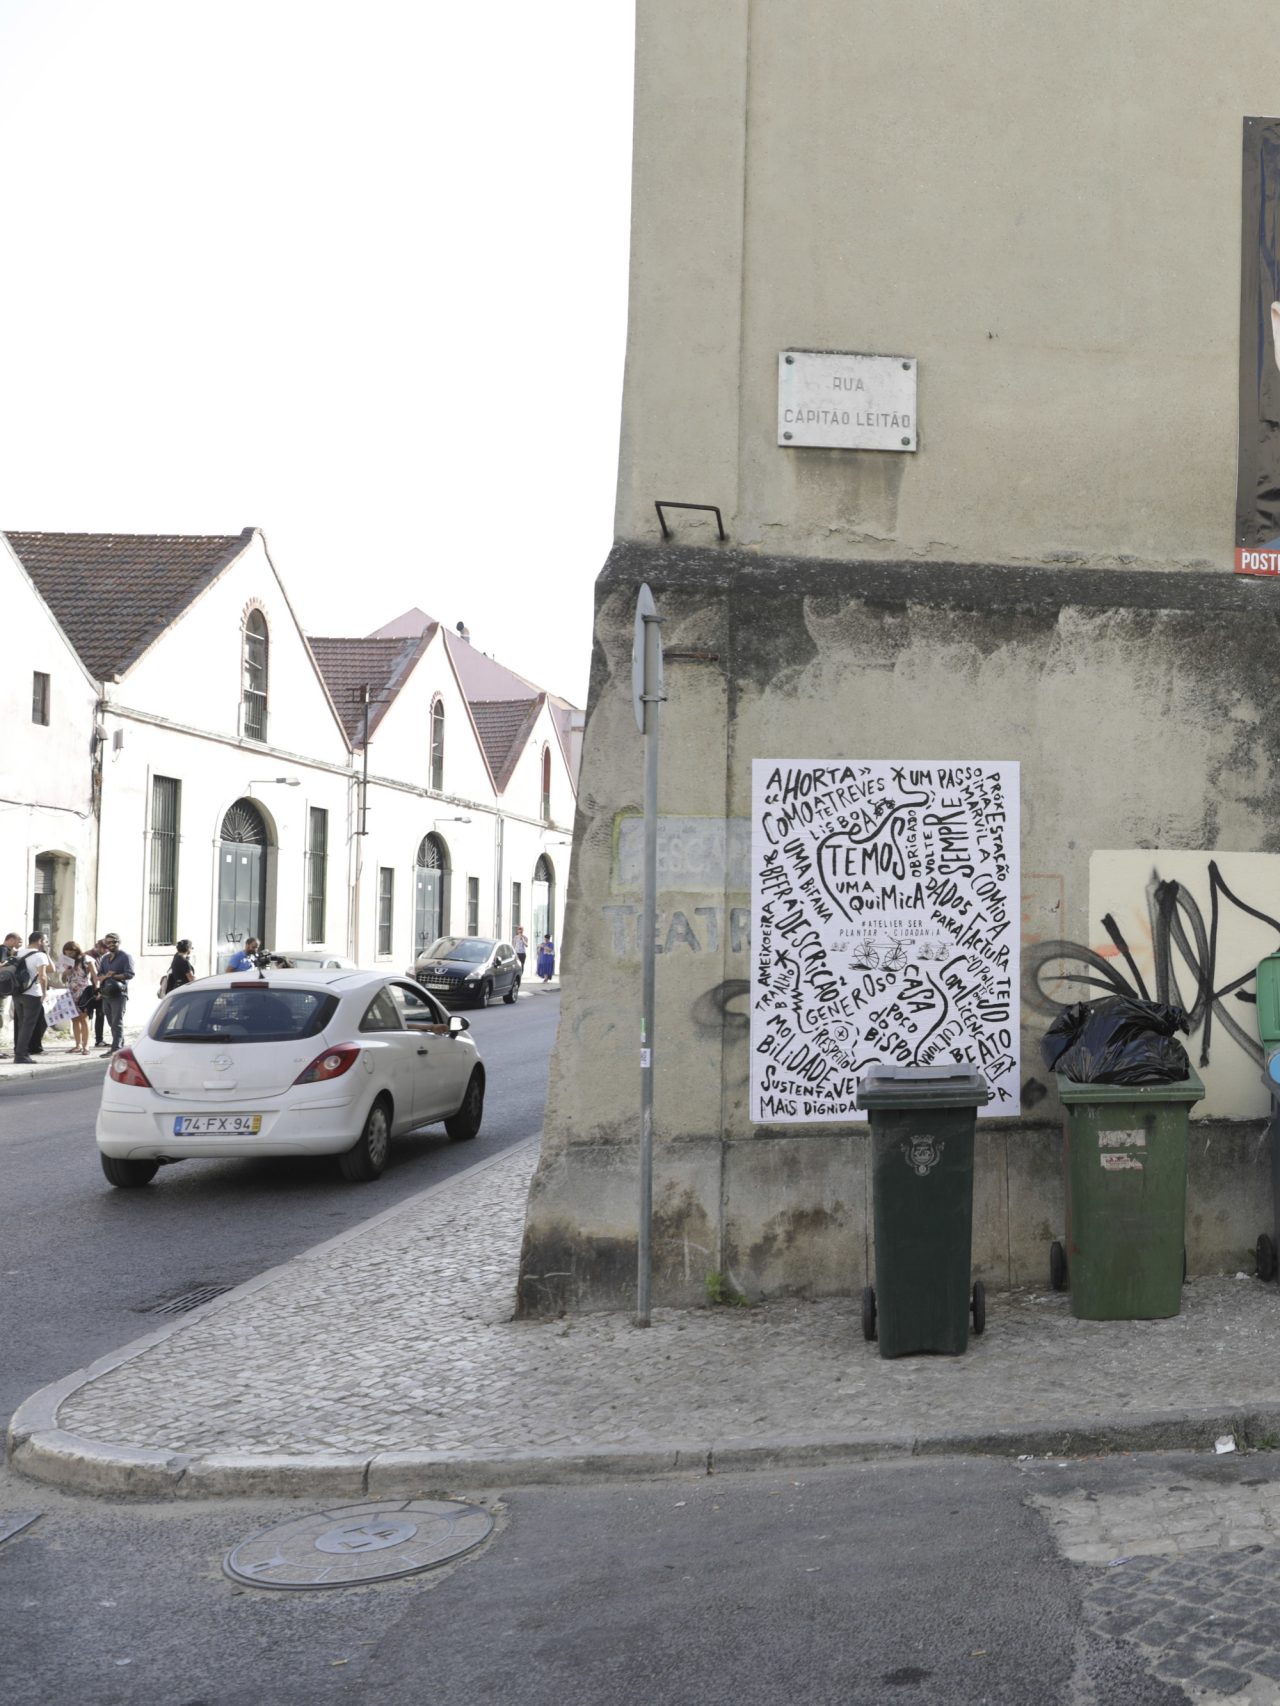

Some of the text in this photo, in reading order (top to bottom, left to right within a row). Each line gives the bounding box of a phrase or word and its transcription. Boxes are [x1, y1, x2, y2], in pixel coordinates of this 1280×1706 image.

[832, 377, 865, 392] RUA
[784, 408, 911, 428] CAPITÃO LEITÃO
[909, 766, 983, 789] UM PASSO
[762, 801, 814, 845] COMO
[783, 838, 813, 880] UMA
[824, 815, 906, 881] TEMOS
[923, 831, 936, 876] VOLTE
[835, 880, 875, 894] UMA
[925, 876, 974, 915] DADOS
[840, 928, 878, 937] PLANTAR
[908, 919, 923, 928] SER
[930, 909, 964, 939] PARA
[956, 912, 1010, 973] FACTURA
[806, 972, 896, 1025] GENEROSO
[896, 964, 936, 1013] CASA
[949, 1029, 1011, 1065] BEATO
